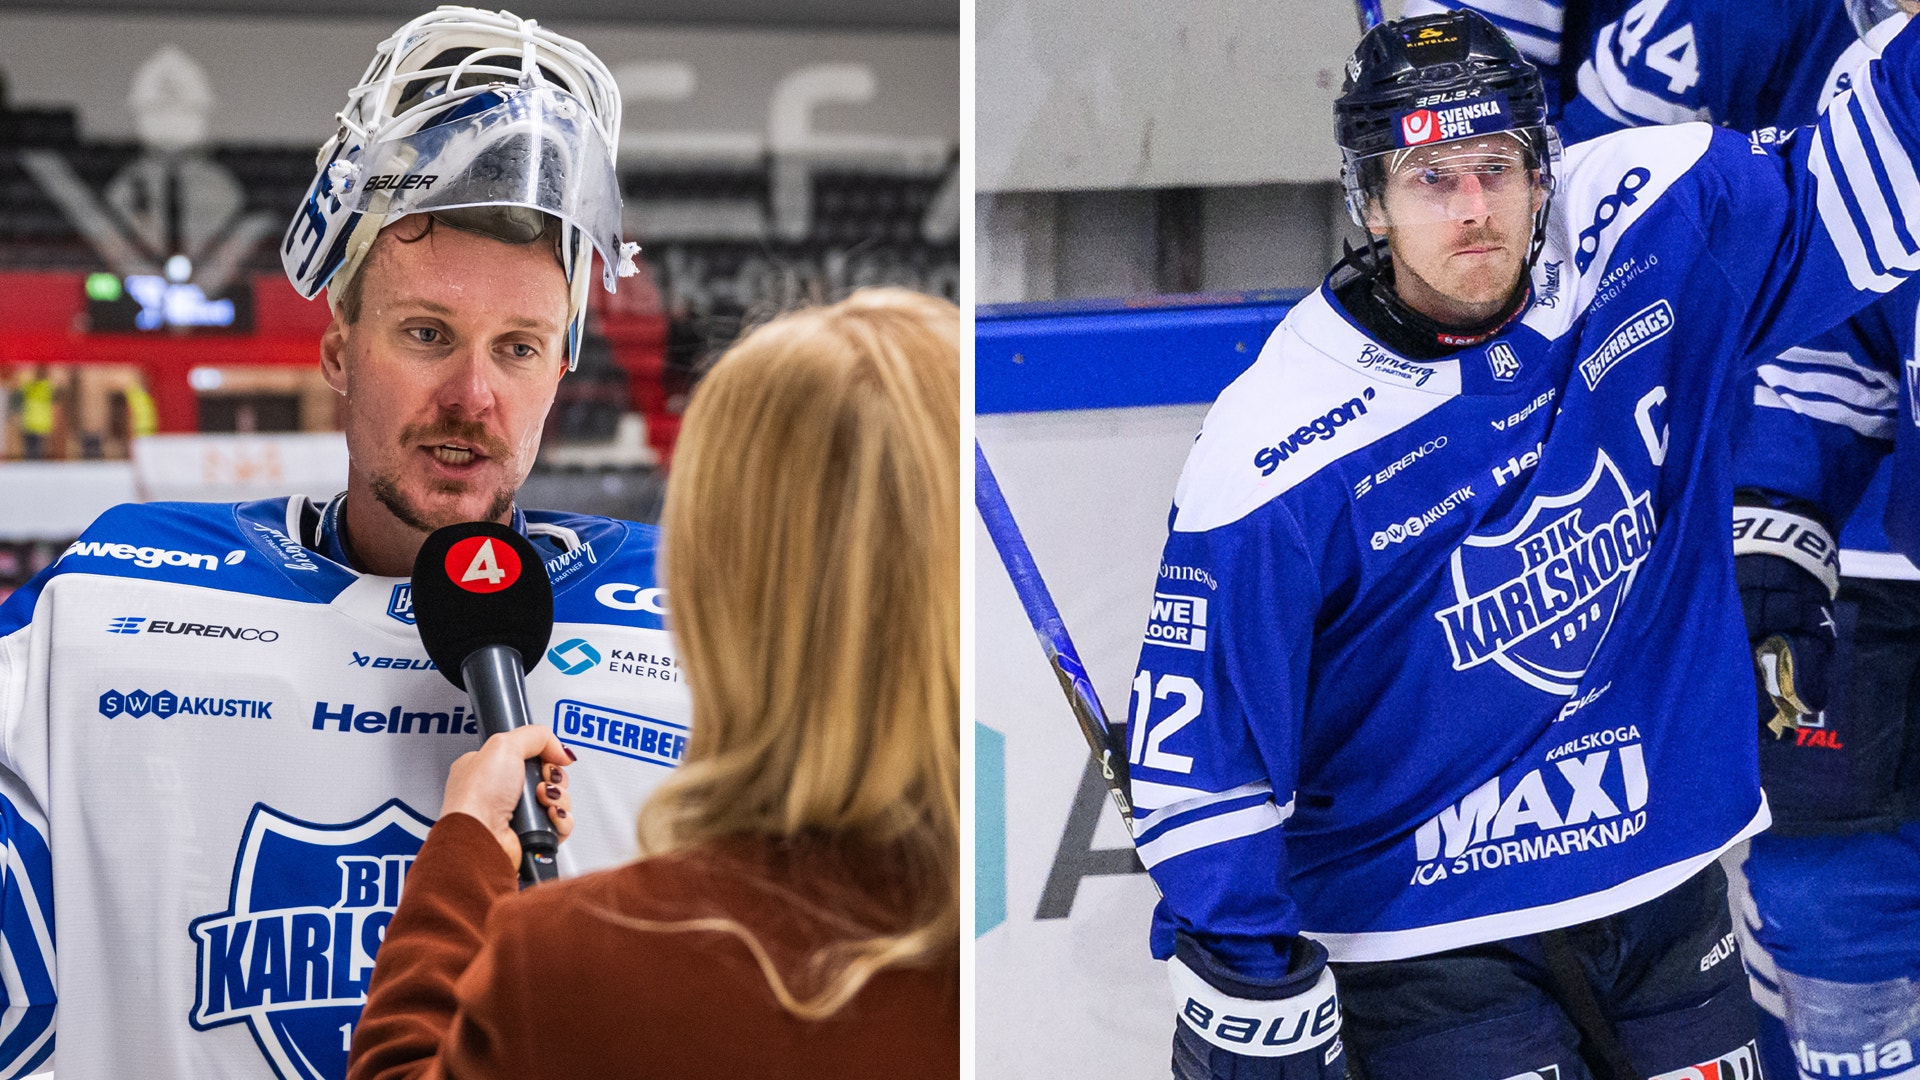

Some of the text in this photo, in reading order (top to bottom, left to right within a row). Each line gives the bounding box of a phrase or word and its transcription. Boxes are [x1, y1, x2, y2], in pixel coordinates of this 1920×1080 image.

[1437, 100, 1501, 125] SVENSKA
[1440, 121, 1474, 139] SPEL
[1586, 308, 1670, 382] ÖSTERBERGS
[1254, 396, 1368, 477] Swegon
[1634, 386, 1669, 466] C
[1375, 436, 1448, 485] EURENCO
[1492, 441, 1543, 486] Hel
[461, 538, 505, 584] 4
[1518, 511, 1584, 570] BIK
[1440, 498, 1655, 666] KARLSKOGA
[147, 620, 279, 643] EURENCO
[1550, 603, 1601, 650] 1978
[563, 706, 687, 760] ÖSTERBER
[1129, 669, 1204, 774] 12
[1545, 724, 1641, 762] KARLSKOGA
[1415, 743, 1649, 861] MAXI
[1410, 811, 1647, 886] ICA STORMARKNAD
[202, 909, 396, 1018] KARLS
